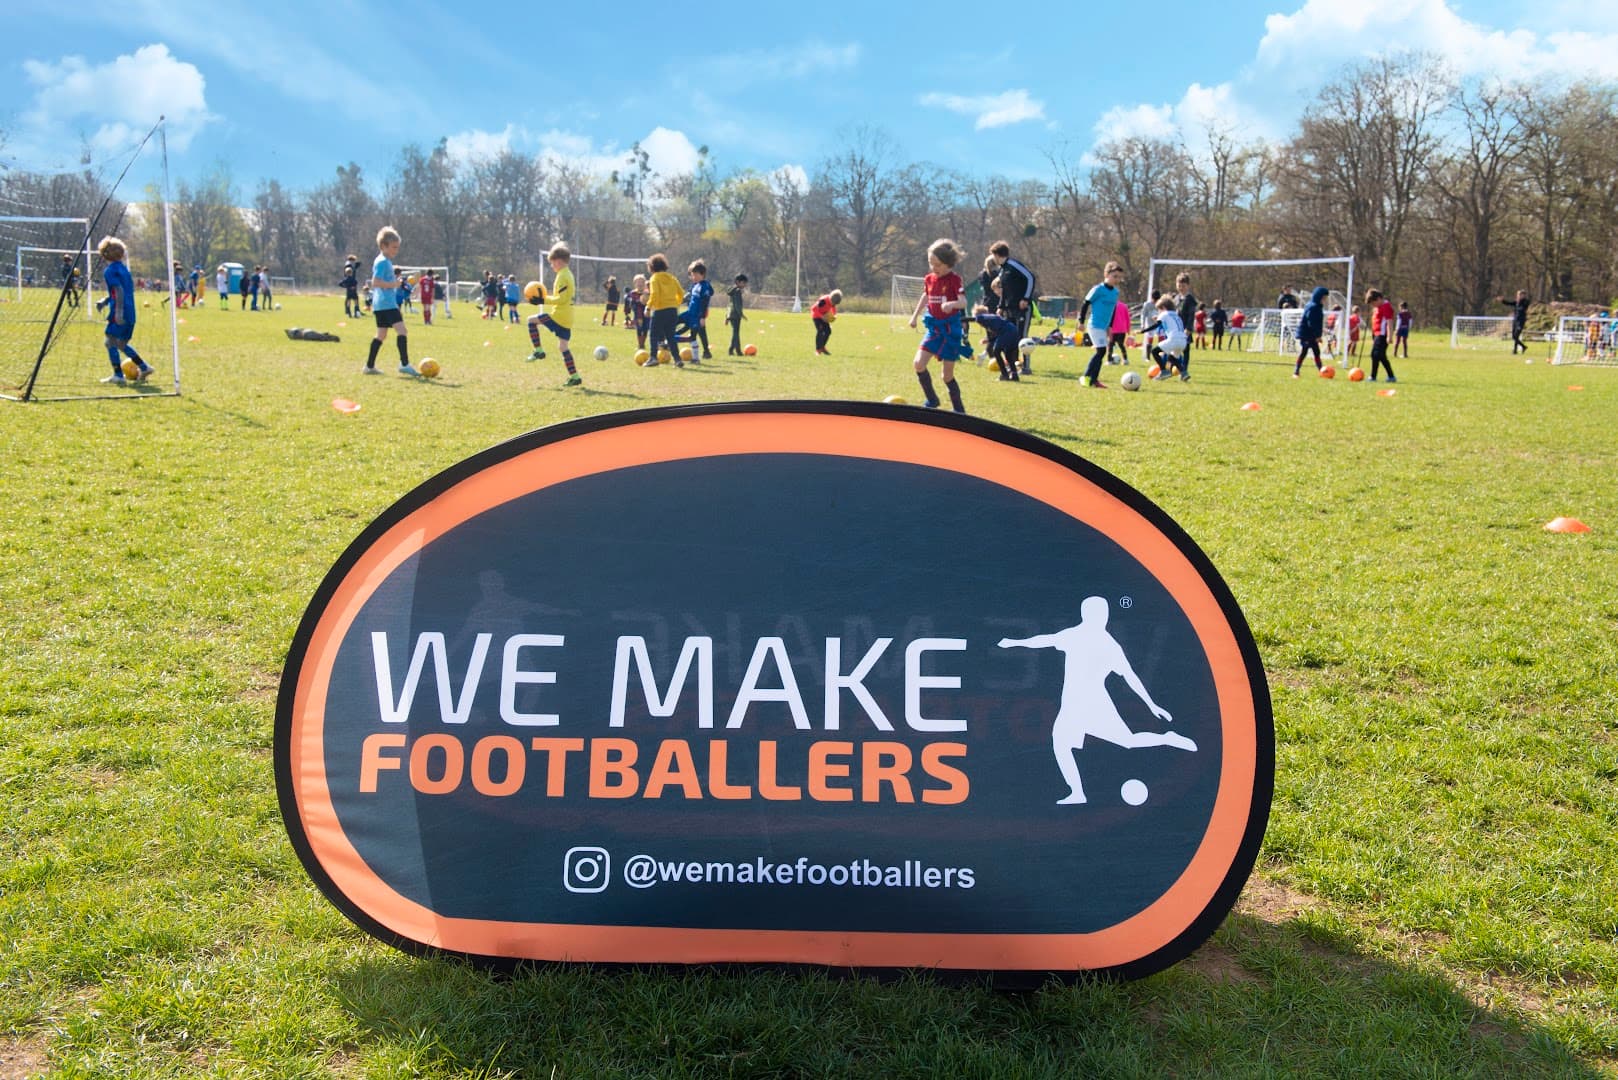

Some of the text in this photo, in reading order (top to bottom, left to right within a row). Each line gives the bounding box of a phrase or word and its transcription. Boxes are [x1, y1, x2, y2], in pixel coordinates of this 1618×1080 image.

[371, 631, 565, 727] WE
[608, 635, 968, 732] MAKE
[358, 733, 970, 805] FOOTBALLERS
[623, 854, 976, 889] @wemakefootballers
